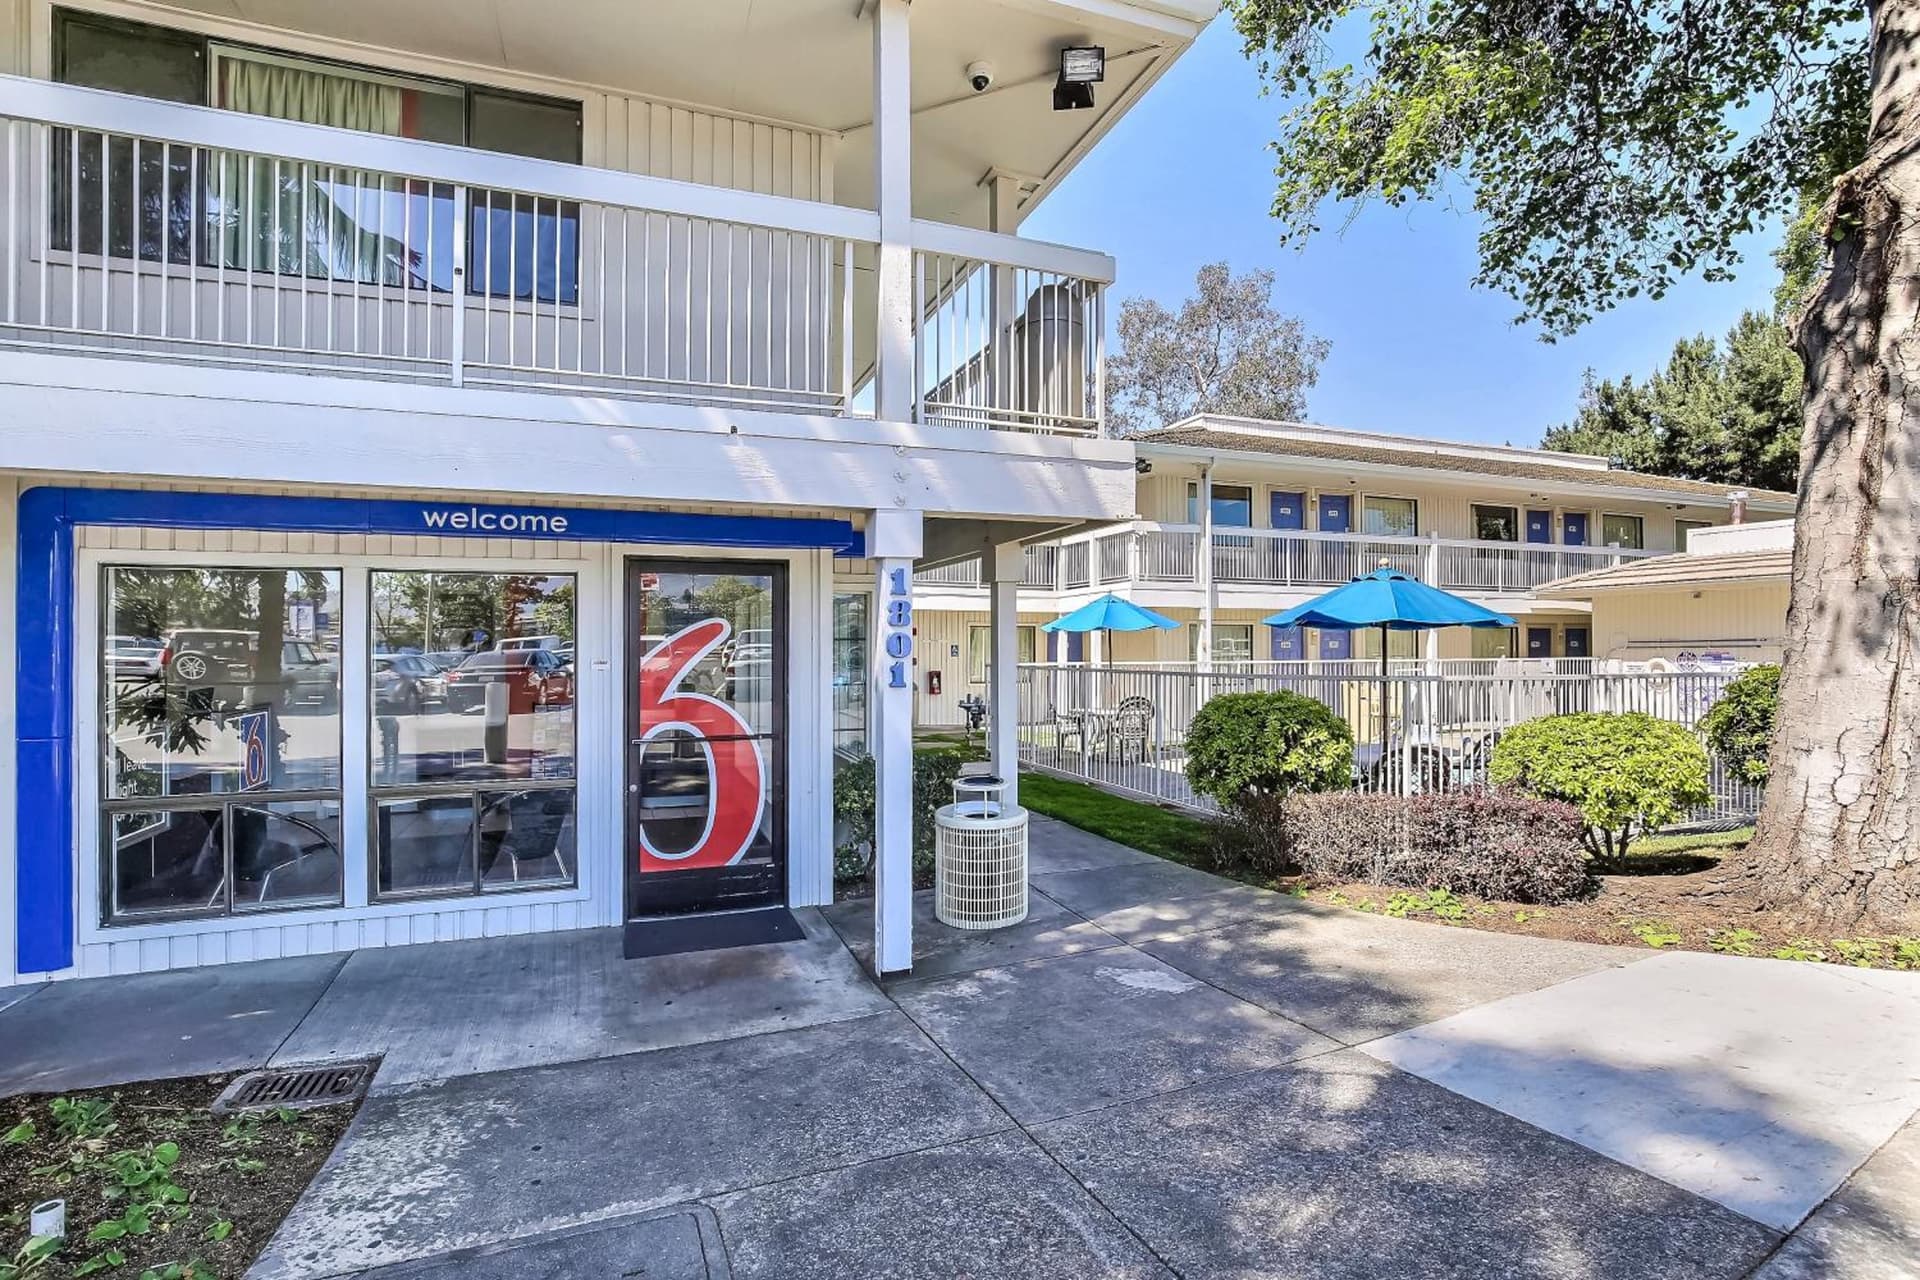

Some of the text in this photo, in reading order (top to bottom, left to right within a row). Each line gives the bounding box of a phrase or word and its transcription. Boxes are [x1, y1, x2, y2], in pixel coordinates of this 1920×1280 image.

[422, 507, 568, 532] welcome
[886, 568, 912, 688] 1801
[245, 715, 264, 788] 6
[639, 617, 766, 873] 6
[118, 780, 138, 798] ight
